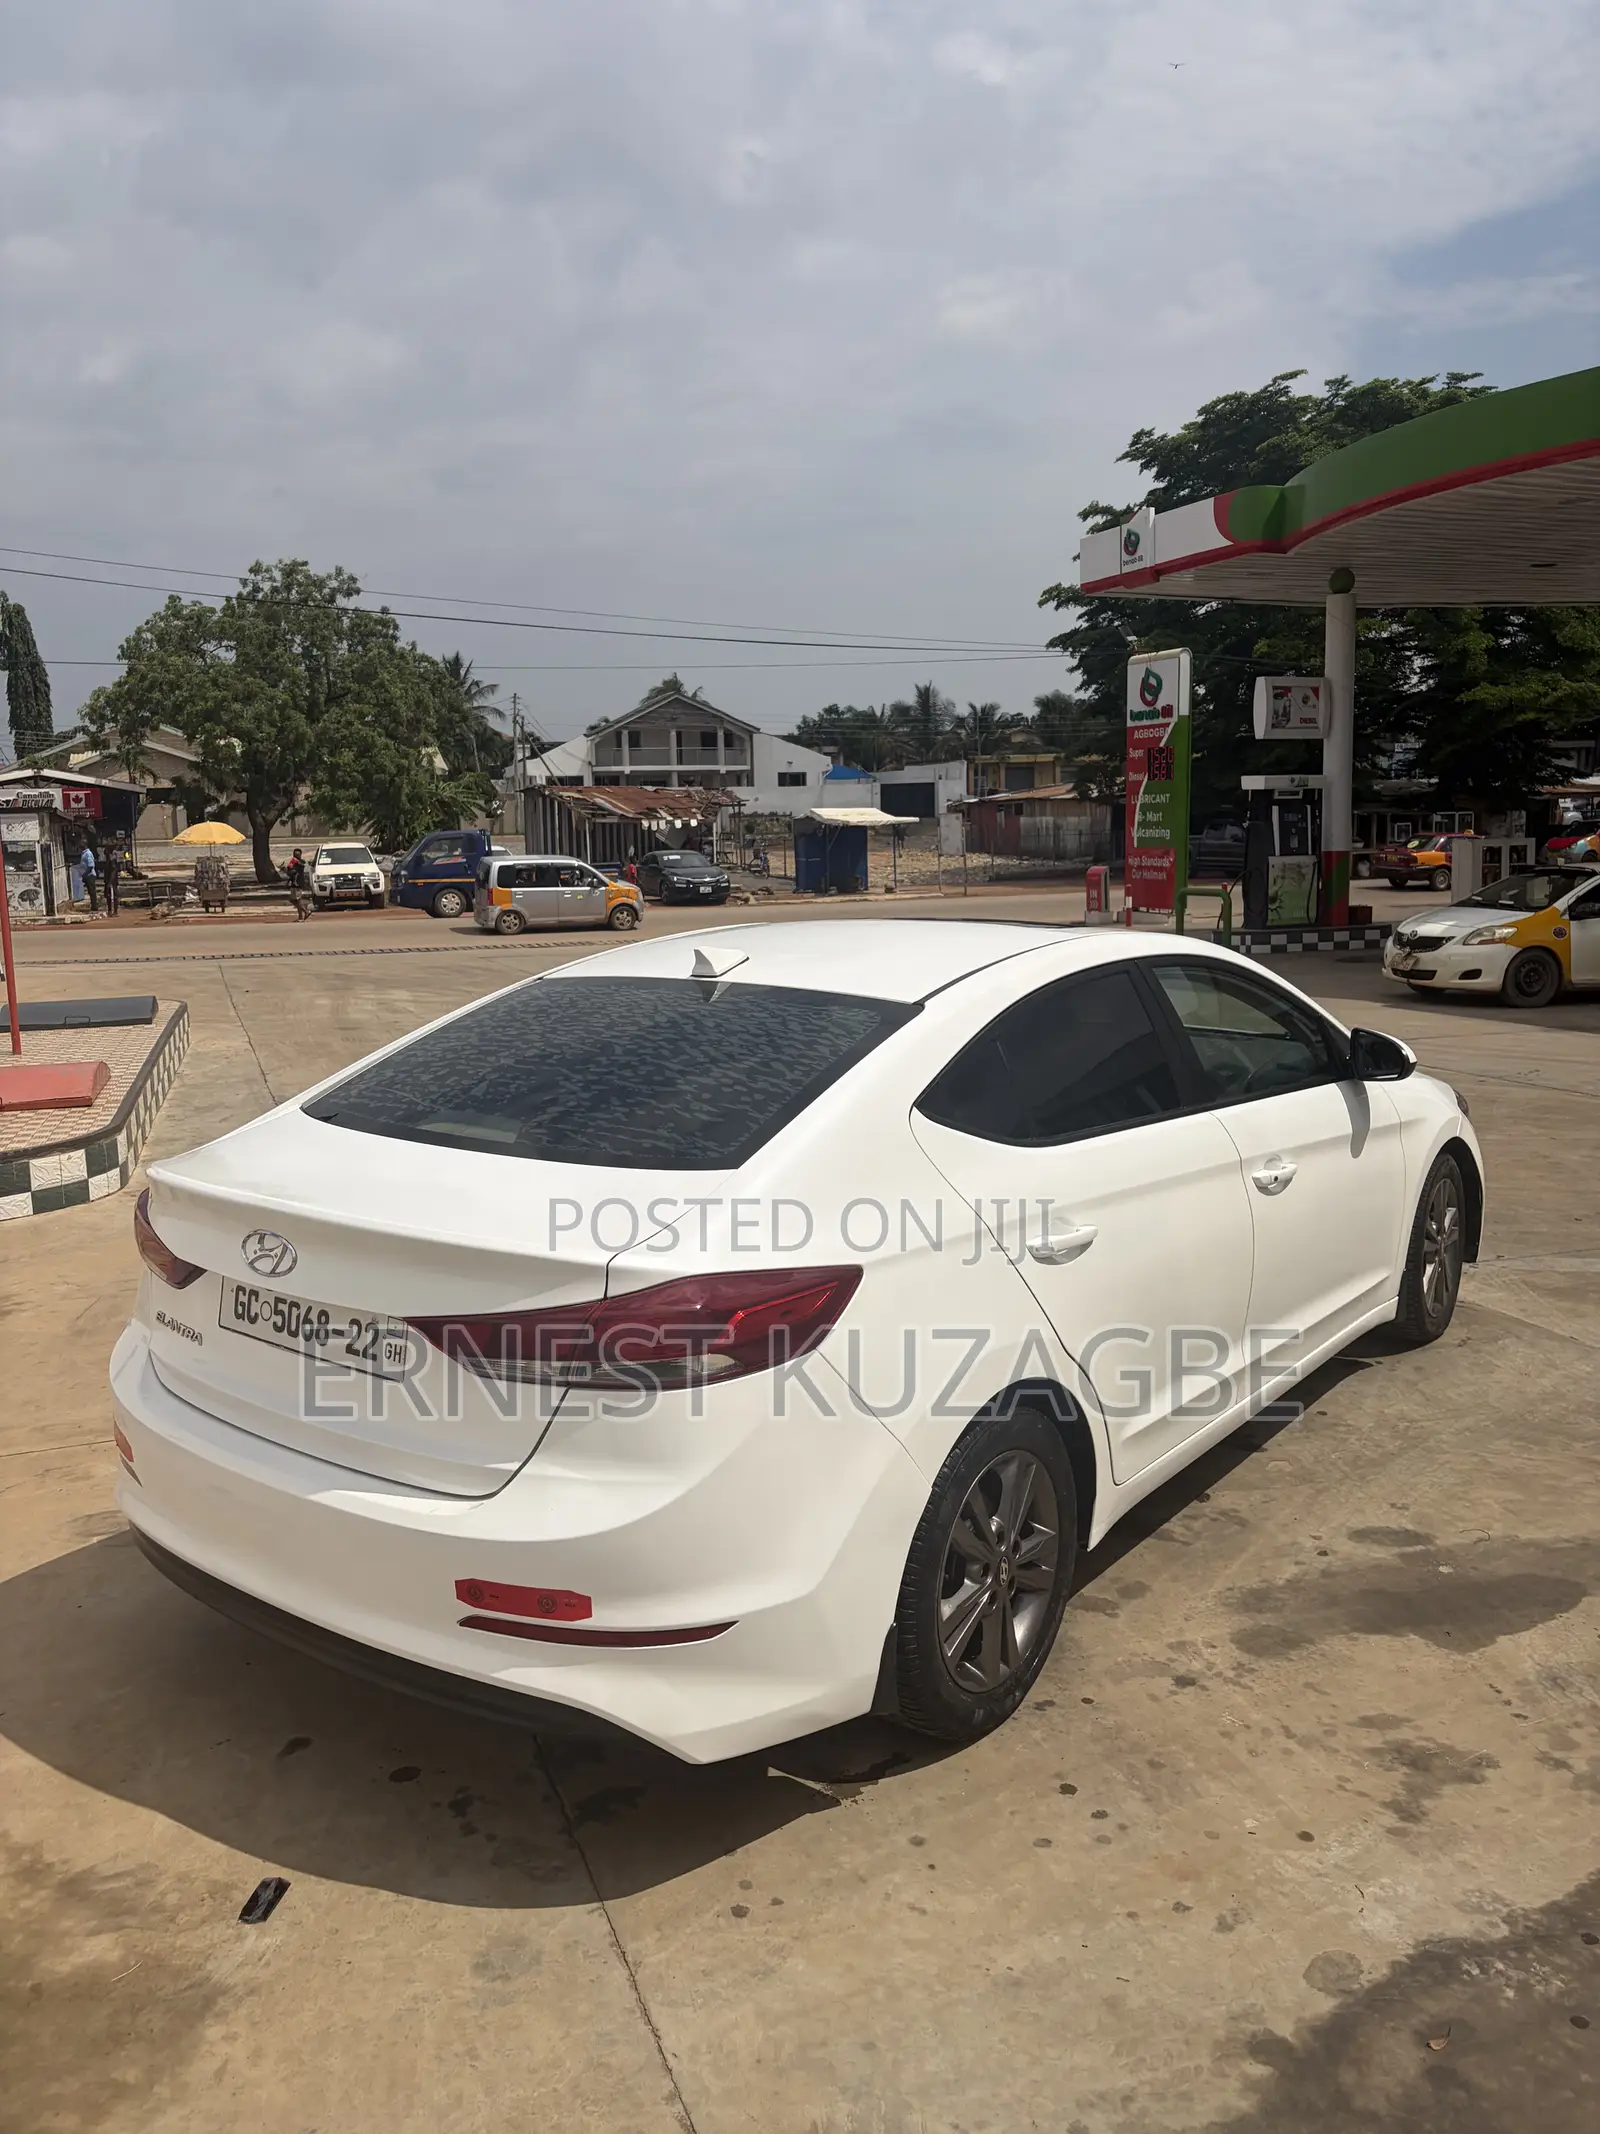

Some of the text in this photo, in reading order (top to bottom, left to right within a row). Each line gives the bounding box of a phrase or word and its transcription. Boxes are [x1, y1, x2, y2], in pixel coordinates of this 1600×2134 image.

[1129, 747, 1145, 760] Super
[1129, 771, 1145, 781] Diesel
[1131, 793, 1170, 804] LUBRICANT
[1146, 811, 1163, 822] Mart
[1130, 826, 1171, 840] Vulcanizing
[156, 1310, 203, 1346] ELANTRA
[234, 1284, 402, 1364] GC 5068-22 GH
